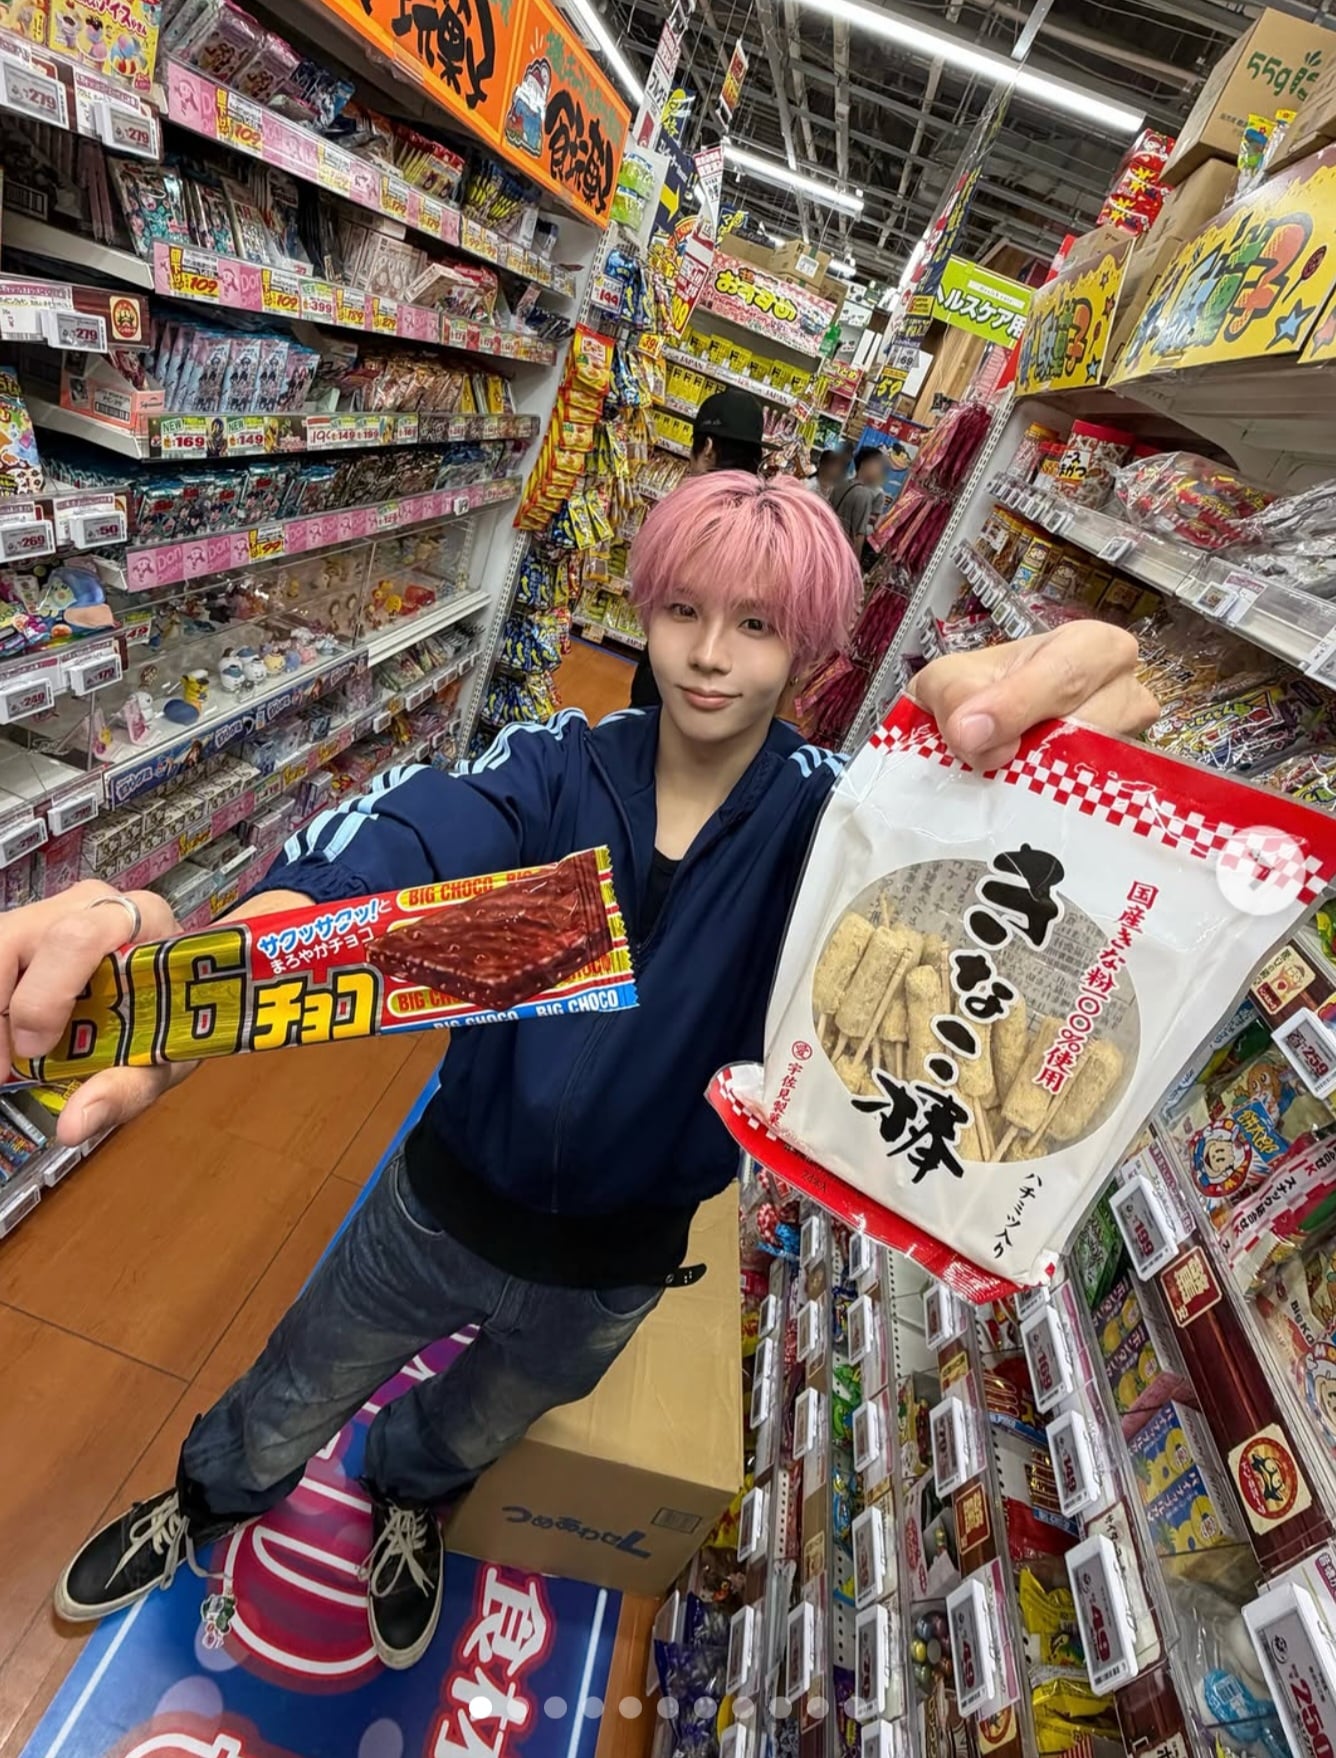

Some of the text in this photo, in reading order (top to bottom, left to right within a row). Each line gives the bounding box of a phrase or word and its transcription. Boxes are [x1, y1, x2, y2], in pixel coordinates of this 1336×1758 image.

[189, 276, 218, 293] 109
[276, 295, 298, 309] 109
[76, 328, 98, 341] 279
[176, 436, 205, 448] 169
[239, 434, 263, 446] 149
[409, 876, 494, 906] BIG CHOCO
[270, 926, 375, 975] まろやかチョコ
[253, 971, 375, 1051] チョコ
[398, 991, 424, 1012] BIG
[567, 989, 619, 1013] CHOCO
[851, 843, 1065, 1184] きなこ棒
[1302, 1046, 1329, 1076] 259
[993, 1173, 1043, 1260] ハチミツ入り
[1090, 1603, 1111, 1662] 49
[1290, 1680, 1335, 1758] 250
